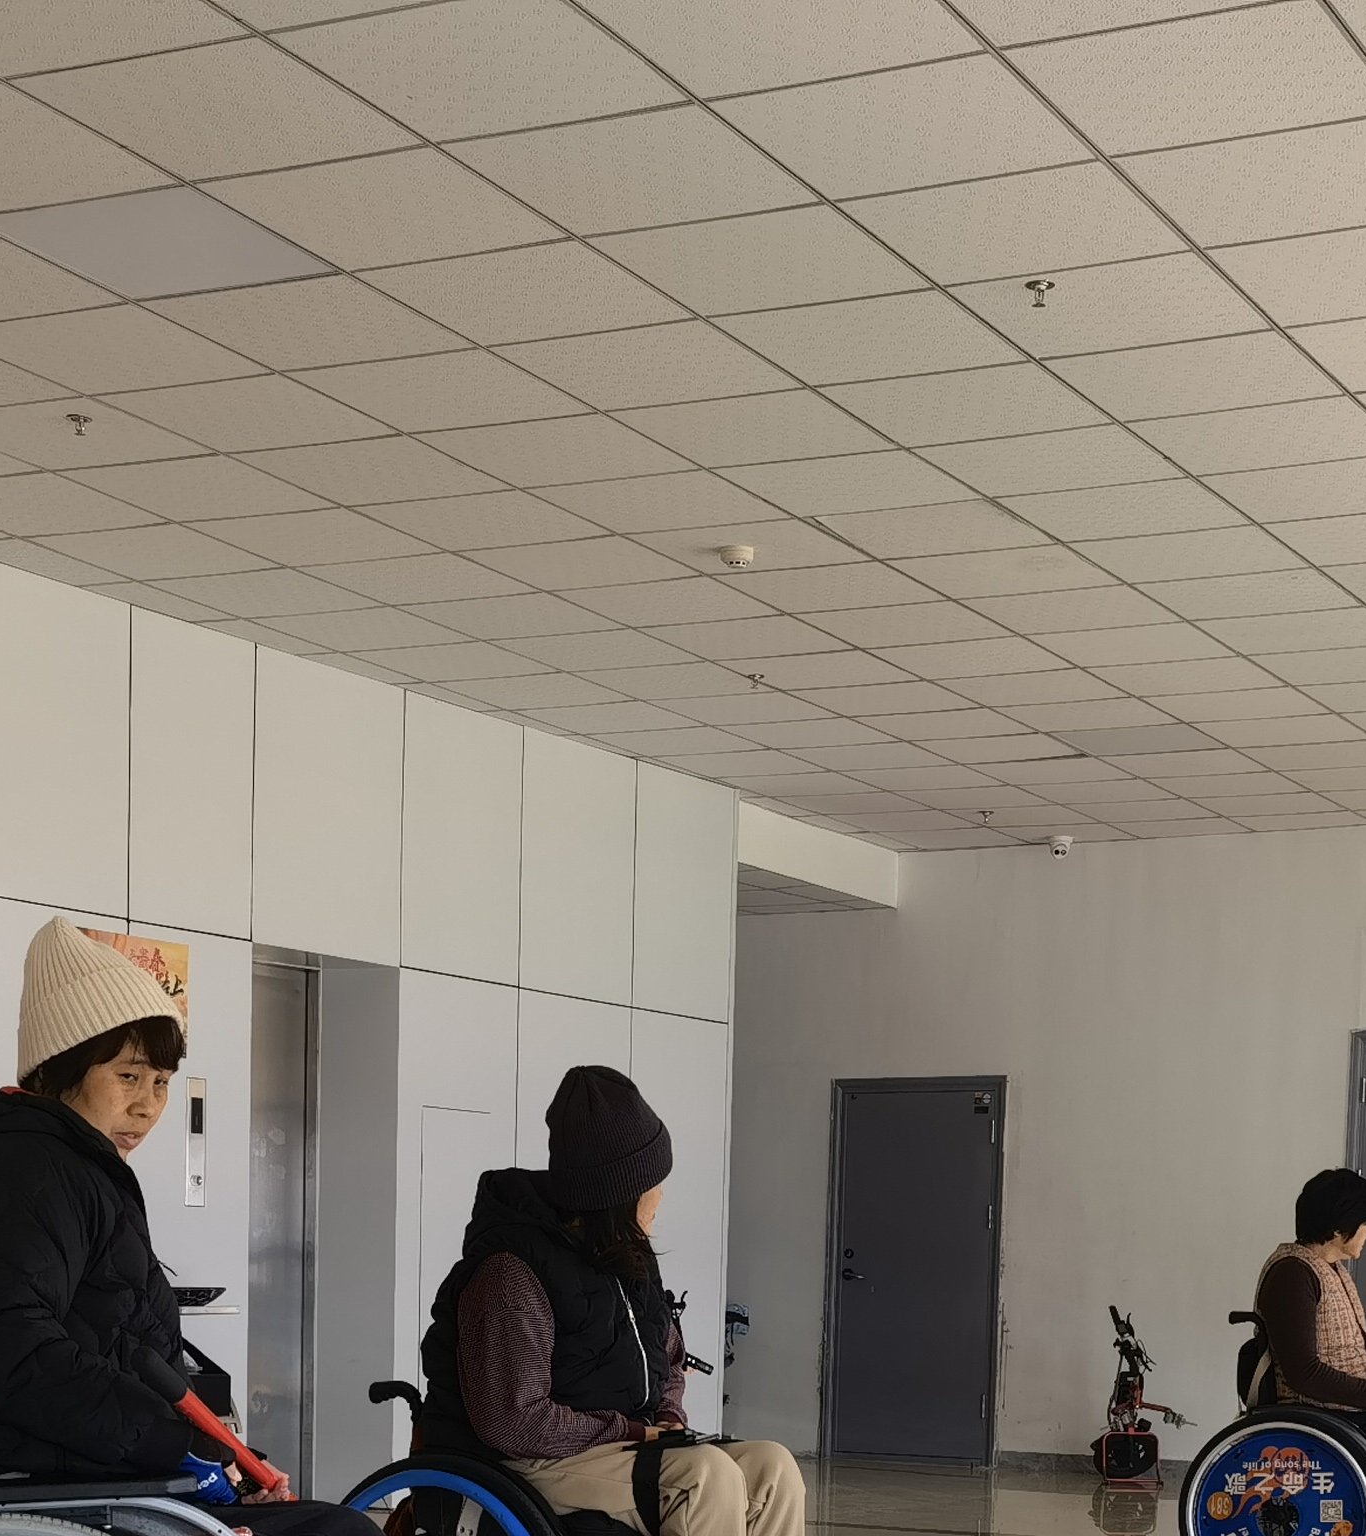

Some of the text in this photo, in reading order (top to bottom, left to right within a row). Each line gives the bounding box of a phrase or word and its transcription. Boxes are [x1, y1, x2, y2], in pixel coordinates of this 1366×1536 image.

[1242, 1458, 1322, 1471] The song of life
[1224, 1471, 1335, 1495] 生命之歌
